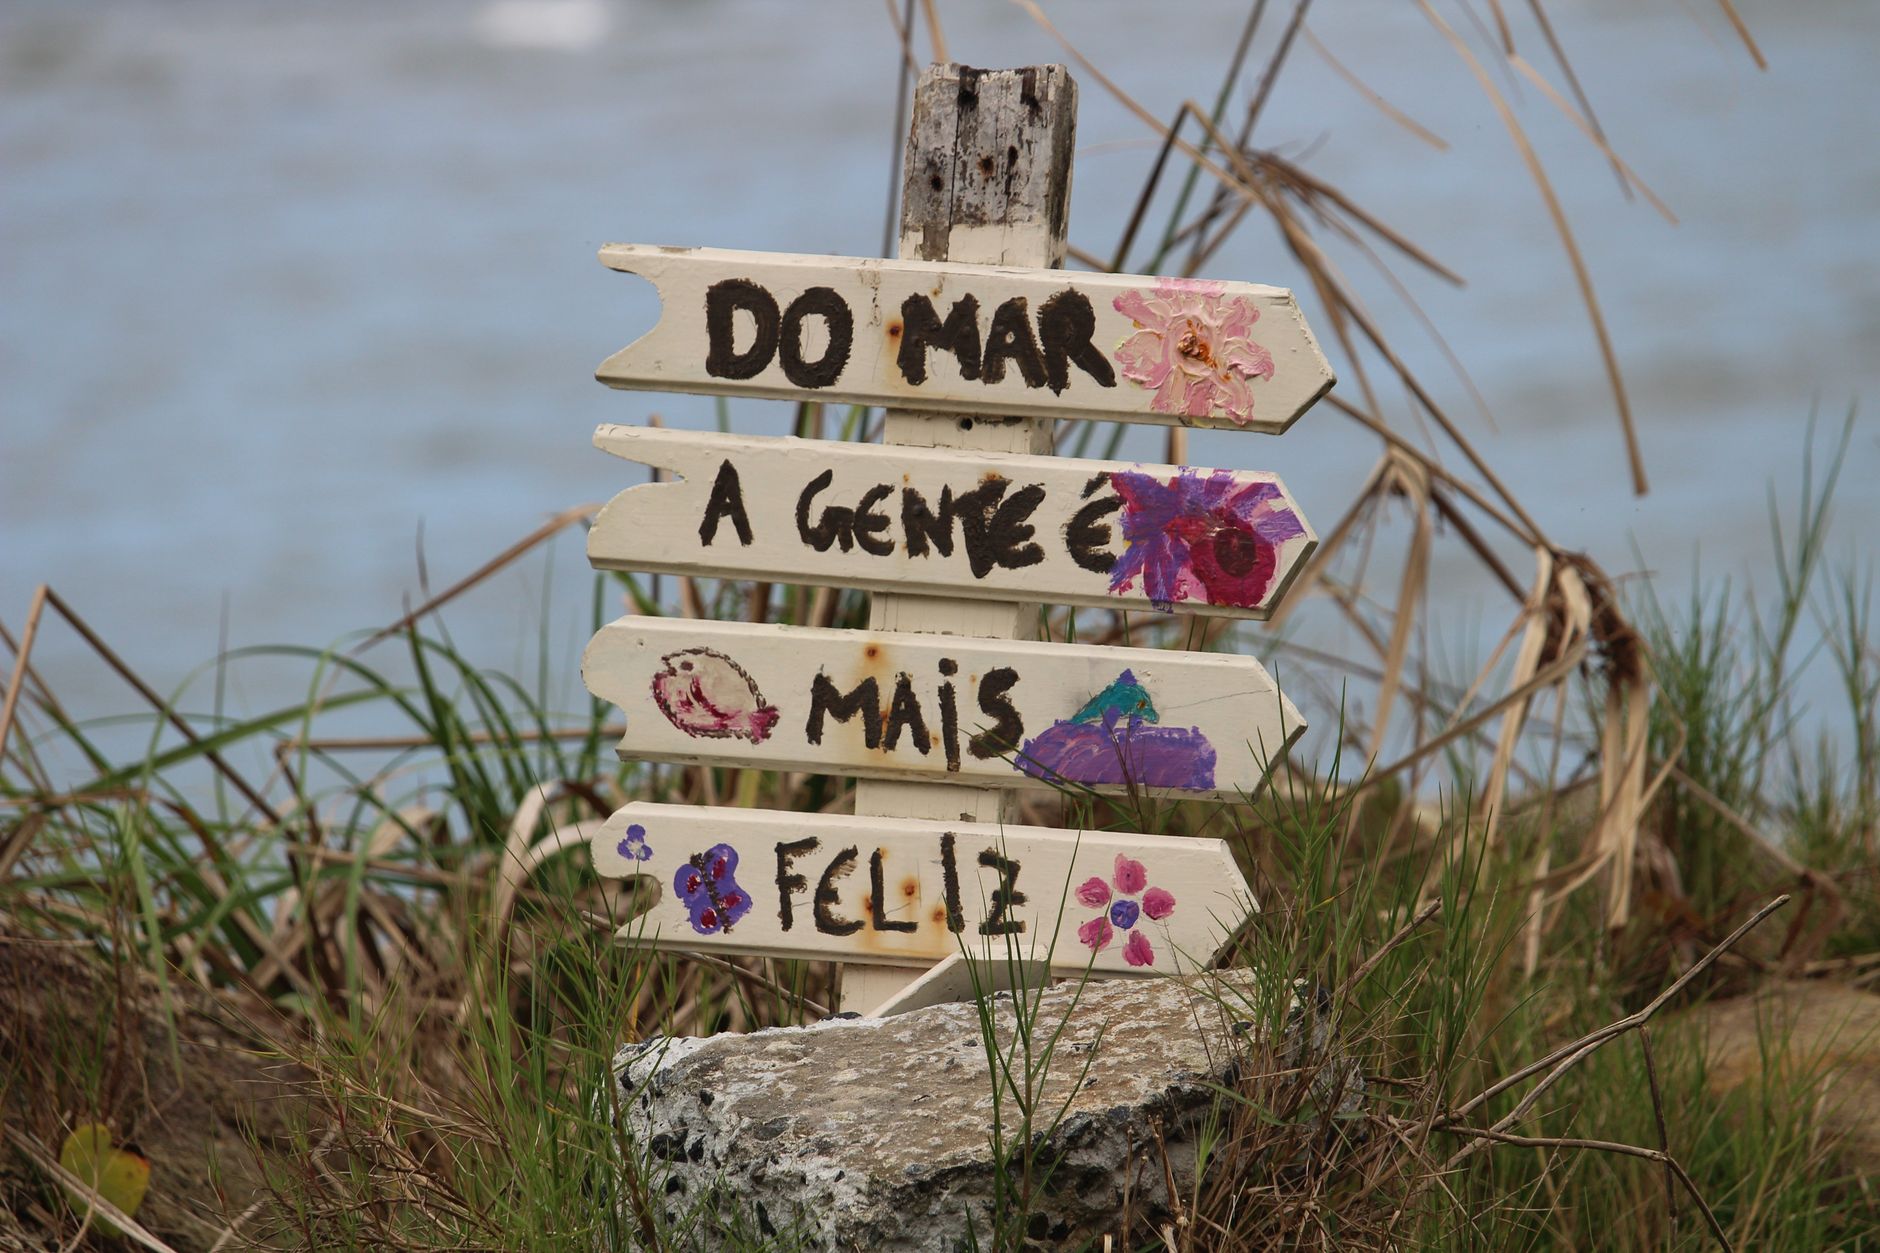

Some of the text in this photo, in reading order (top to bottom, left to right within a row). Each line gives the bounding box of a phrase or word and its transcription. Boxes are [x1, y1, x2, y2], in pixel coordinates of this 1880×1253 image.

[705, 278, 1116, 397] DO MAR
[700, 459, 753, 547] A
[796, 469, 1046, 580] GENTE
[774, 831, 1030, 937] FELIZ
